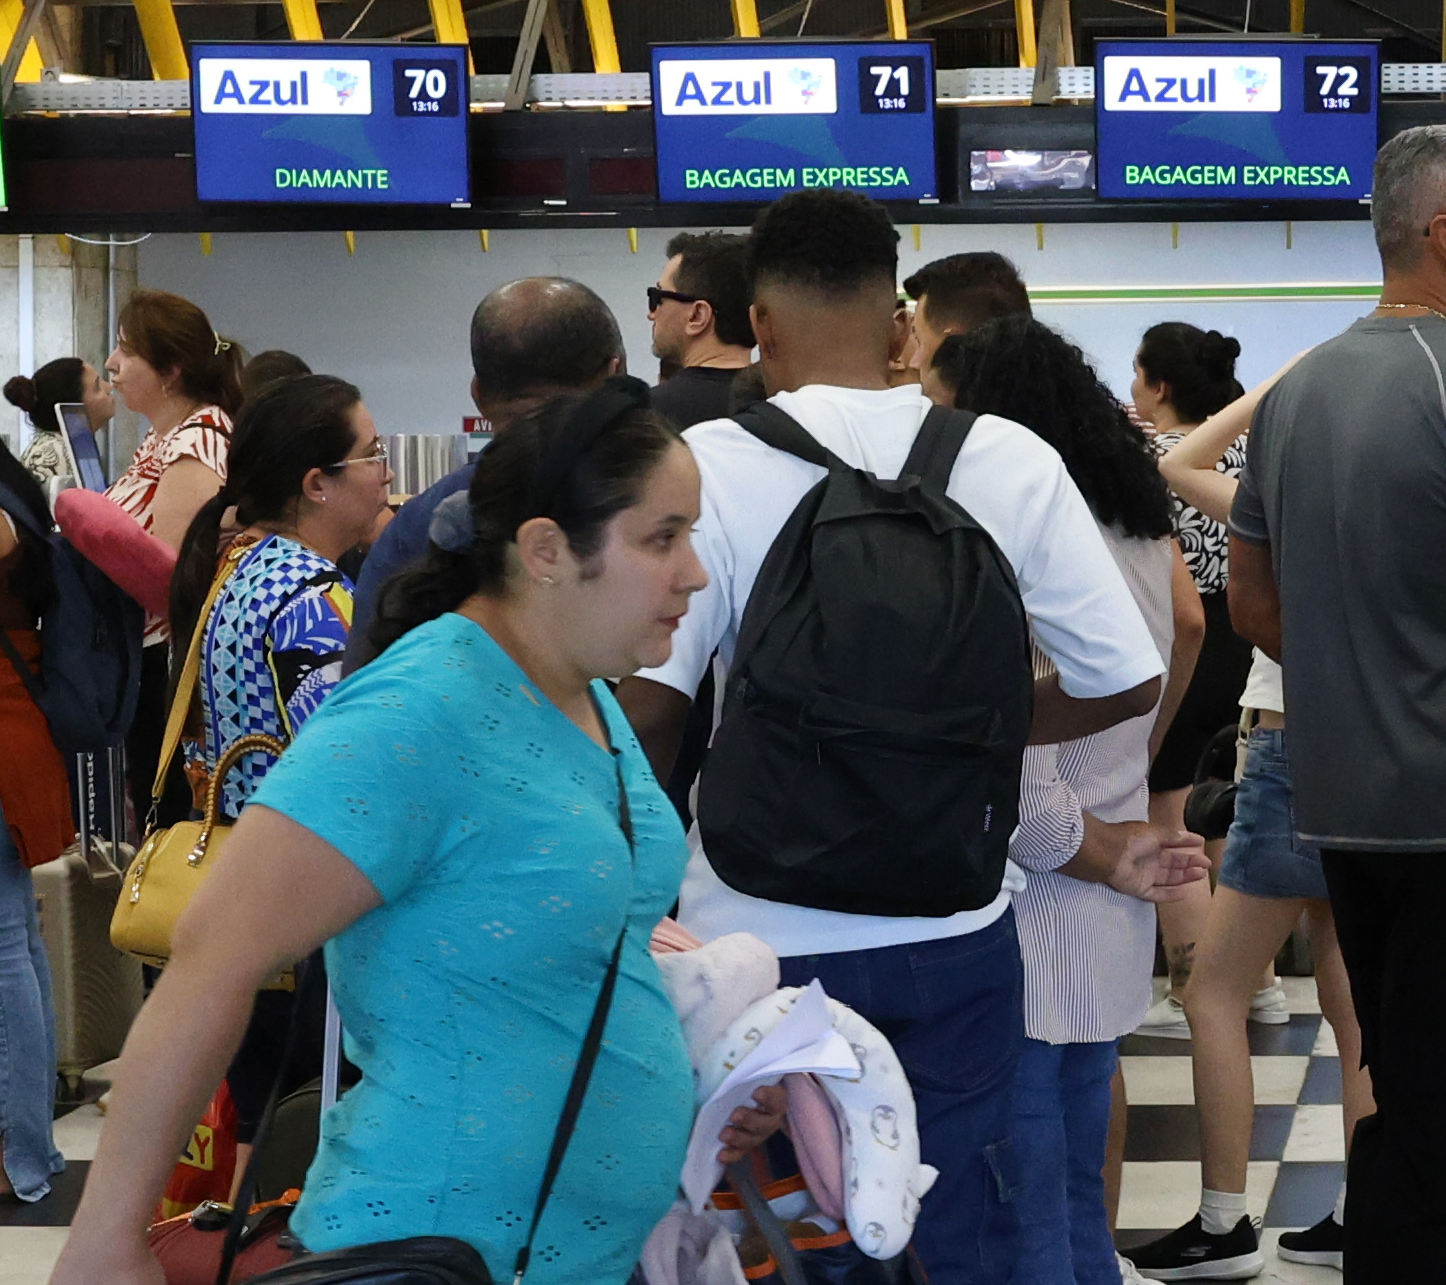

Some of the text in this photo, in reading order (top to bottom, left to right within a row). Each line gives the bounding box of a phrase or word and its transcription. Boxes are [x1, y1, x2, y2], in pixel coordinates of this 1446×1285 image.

[214, 70, 308, 106] Azul
[404, 69, 447, 99] 70
[675, 71, 772, 106] Azul
[870, 66, 909, 96] 71
[1118, 67, 1216, 103] Azul
[1316, 66, 1359, 95] 72
[412, 101, 439, 112] 13:16
[878, 98, 906, 109] 13:16
[1323, 98, 1350, 109] 13:16
[275, 169, 389, 189] DIAMANTE
[685, 167, 910, 189] BAGAGEM EXPRESSA
[1125, 165, 1351, 185] BAGAGEM EXPRESSA
